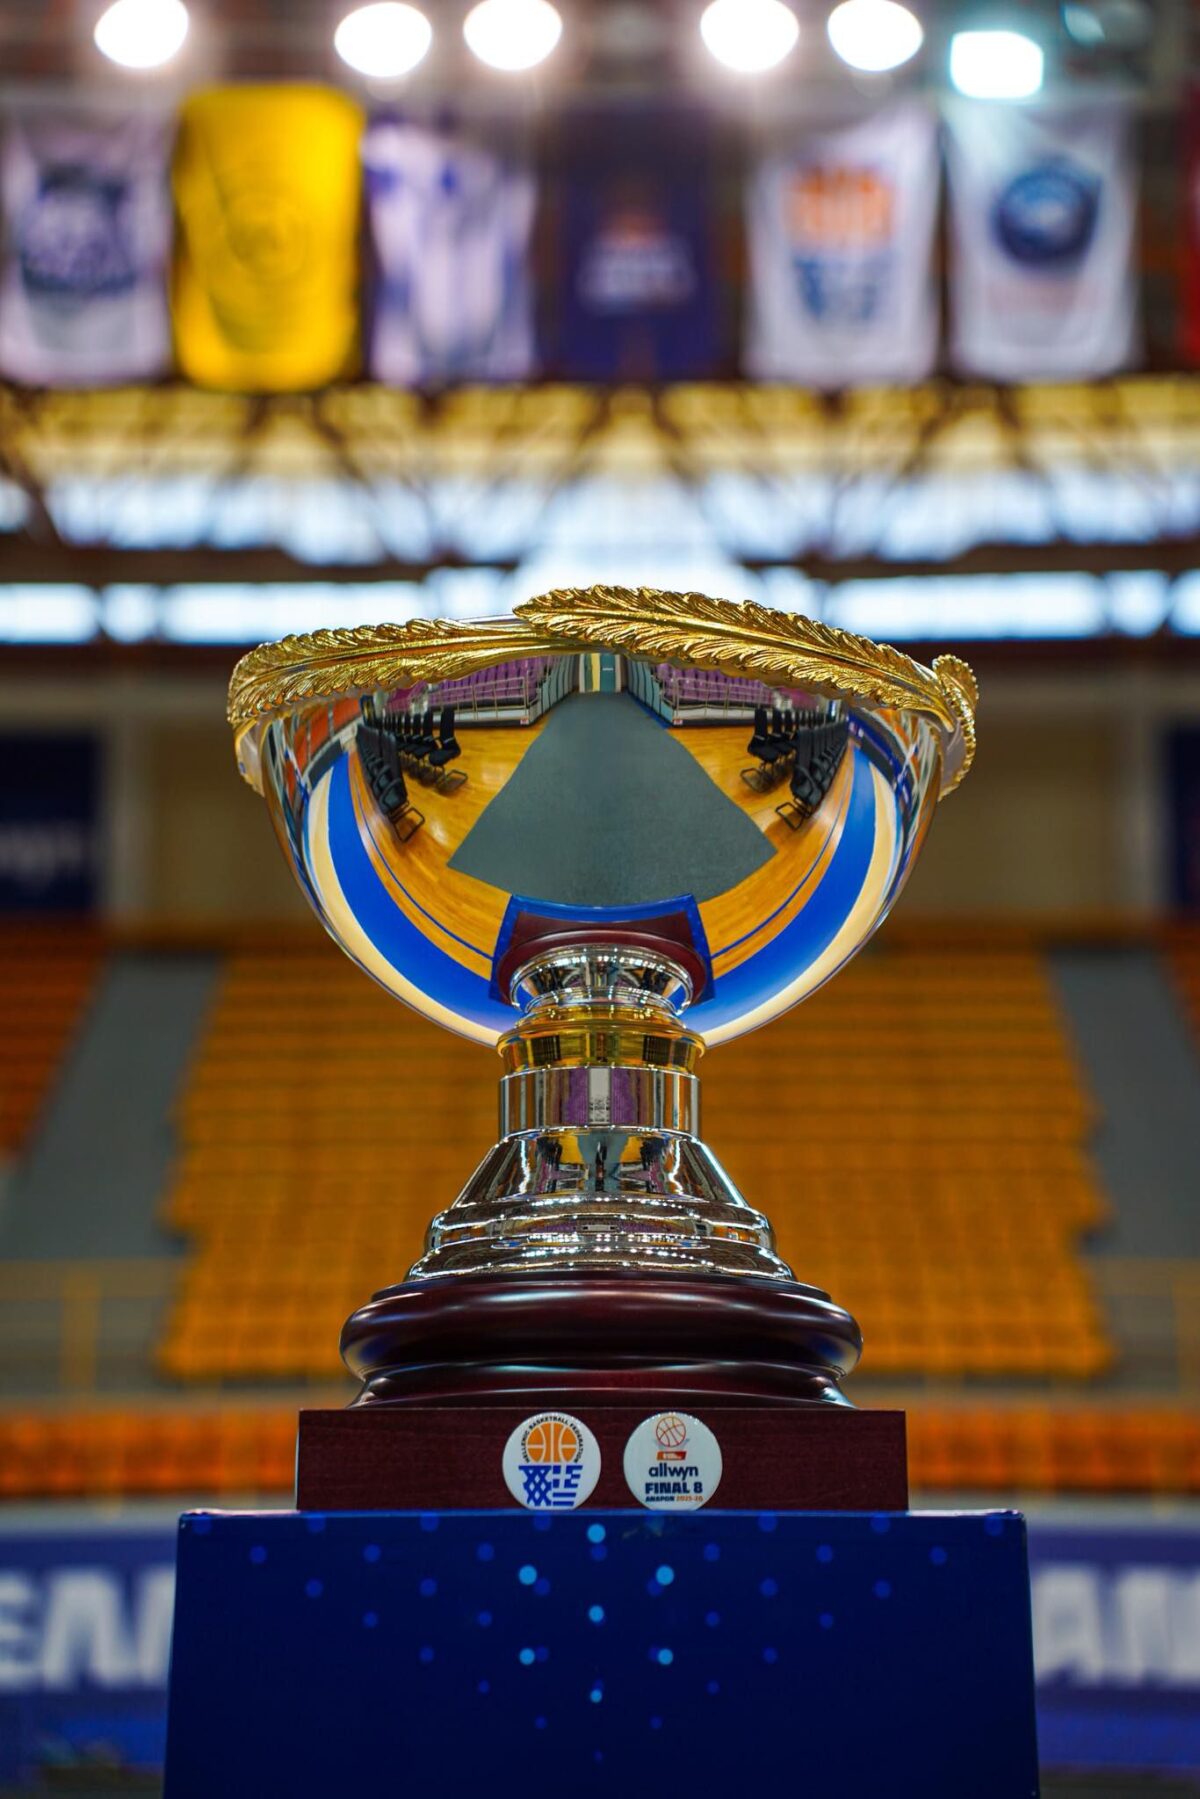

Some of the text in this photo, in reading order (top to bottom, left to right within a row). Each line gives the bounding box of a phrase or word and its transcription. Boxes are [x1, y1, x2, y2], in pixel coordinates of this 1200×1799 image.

[529, 1416, 569, 1430] BASKETBALL
[569, 1423, 584, 1463] FEDERATION
[648, 1462, 699, 1481] allwyn
[645, 1481, 703, 1494] FINAL 8
